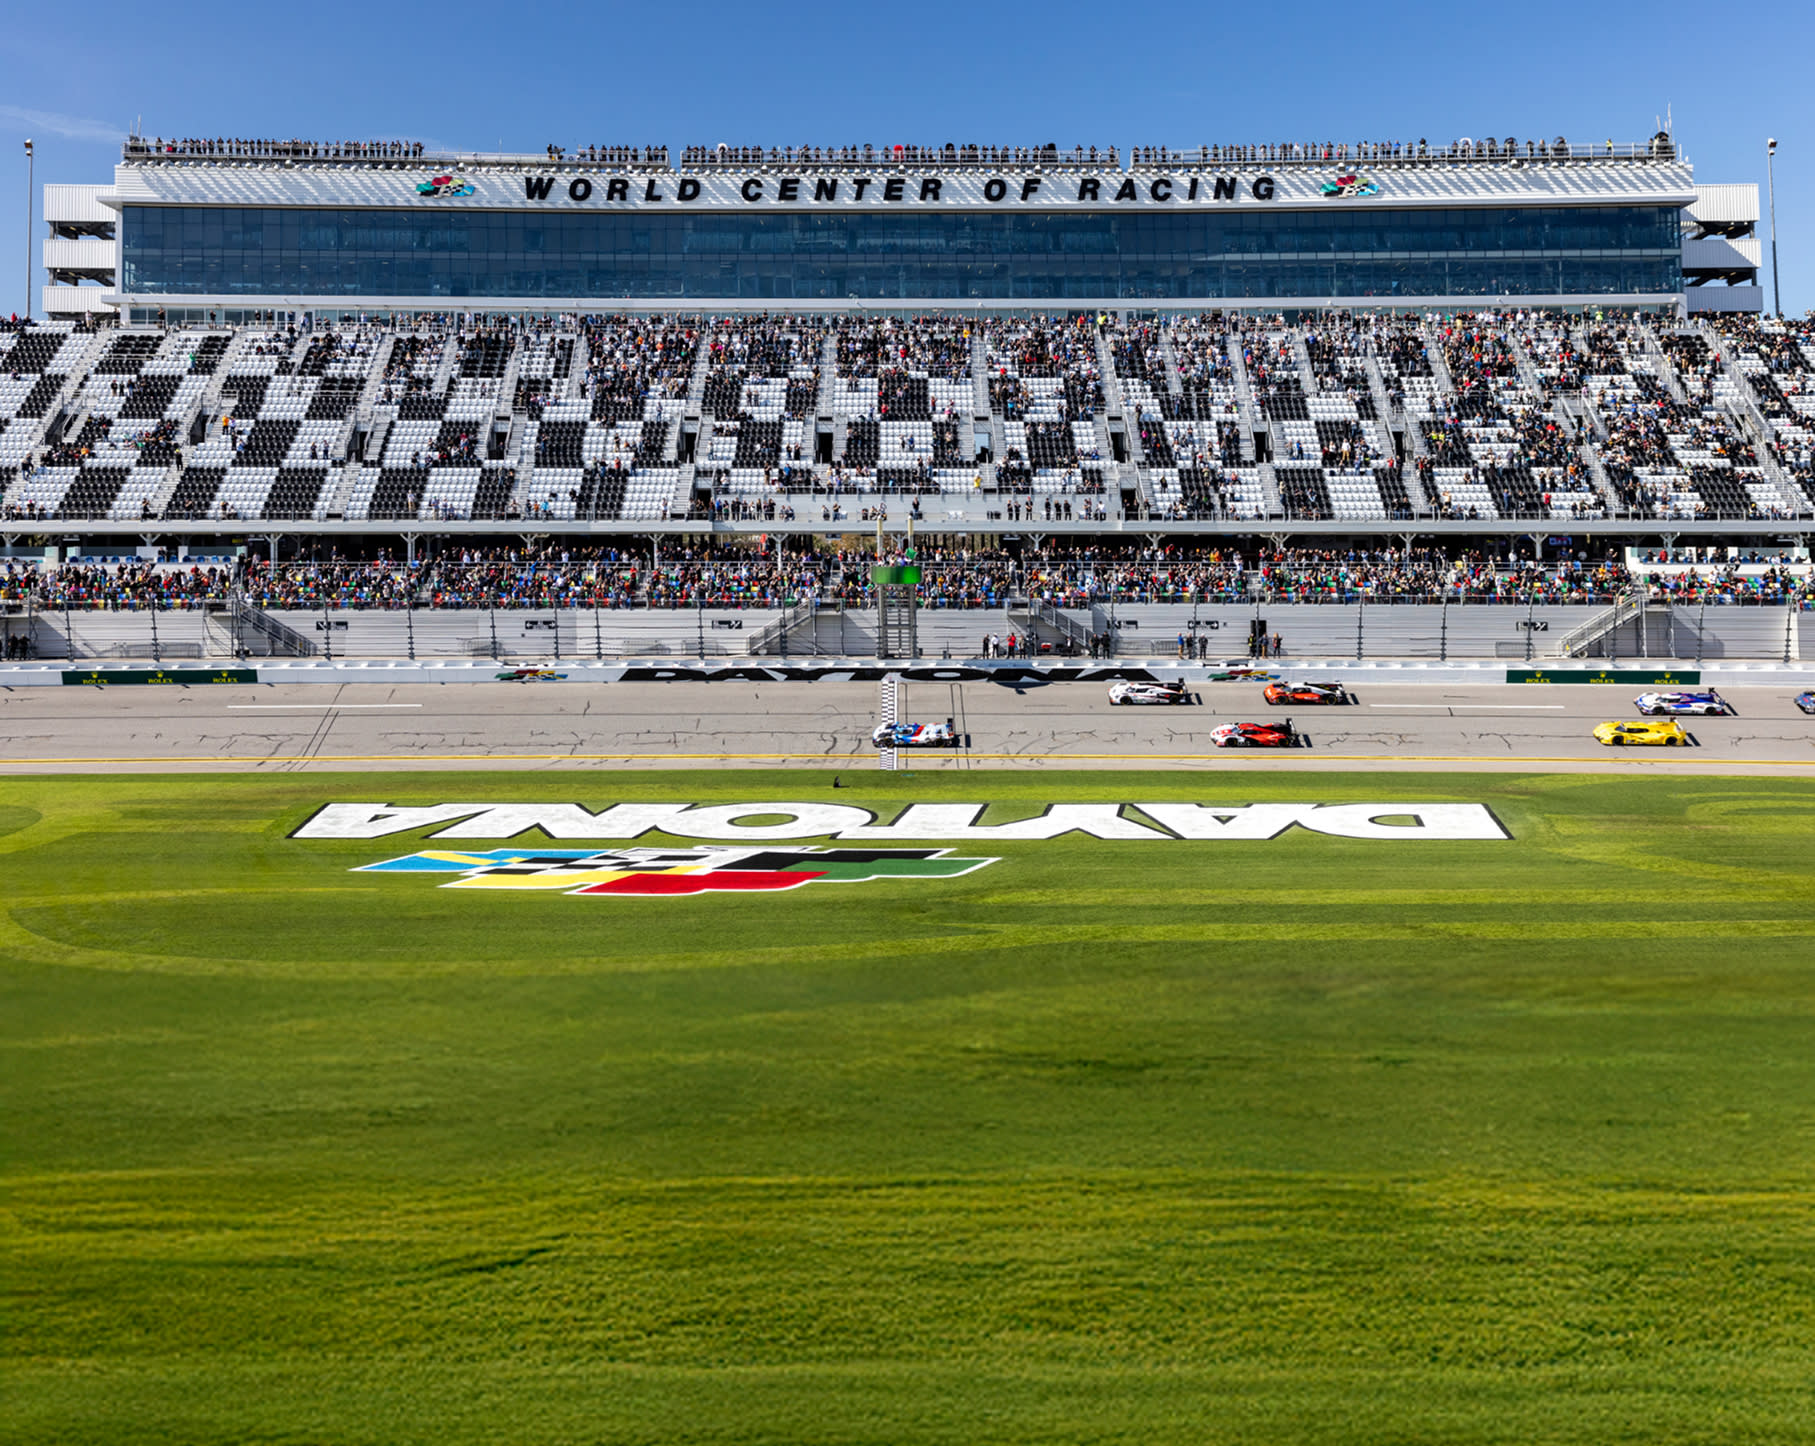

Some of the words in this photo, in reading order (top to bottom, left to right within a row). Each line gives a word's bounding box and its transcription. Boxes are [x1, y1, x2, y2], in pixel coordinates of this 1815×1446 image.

[525, 177, 700, 201] WORLD
[741, 178, 942, 201] CENTER
[984, 178, 1041, 201] OF
[1078, 177, 1275, 201] RACING
[618, 667, 1160, 682] DAYTONA
[286, 801, 1516, 840] DAYTONA
